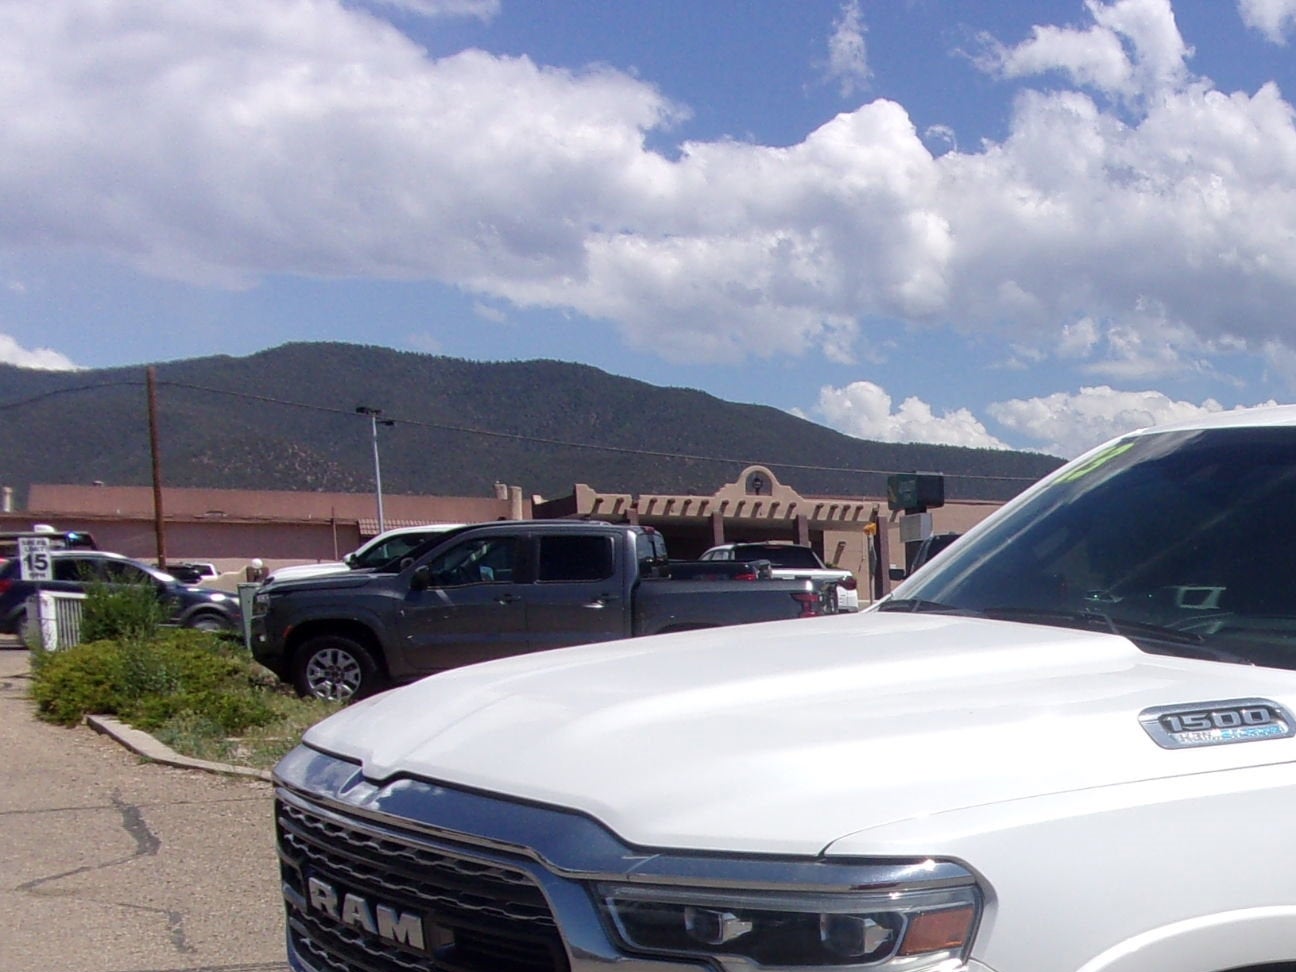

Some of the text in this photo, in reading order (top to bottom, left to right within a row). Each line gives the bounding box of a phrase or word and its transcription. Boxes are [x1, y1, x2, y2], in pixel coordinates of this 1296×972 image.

[23, 553, 49, 571] 15
[1166, 707, 1272, 733] 1500
[308, 876, 426, 950] RAM
